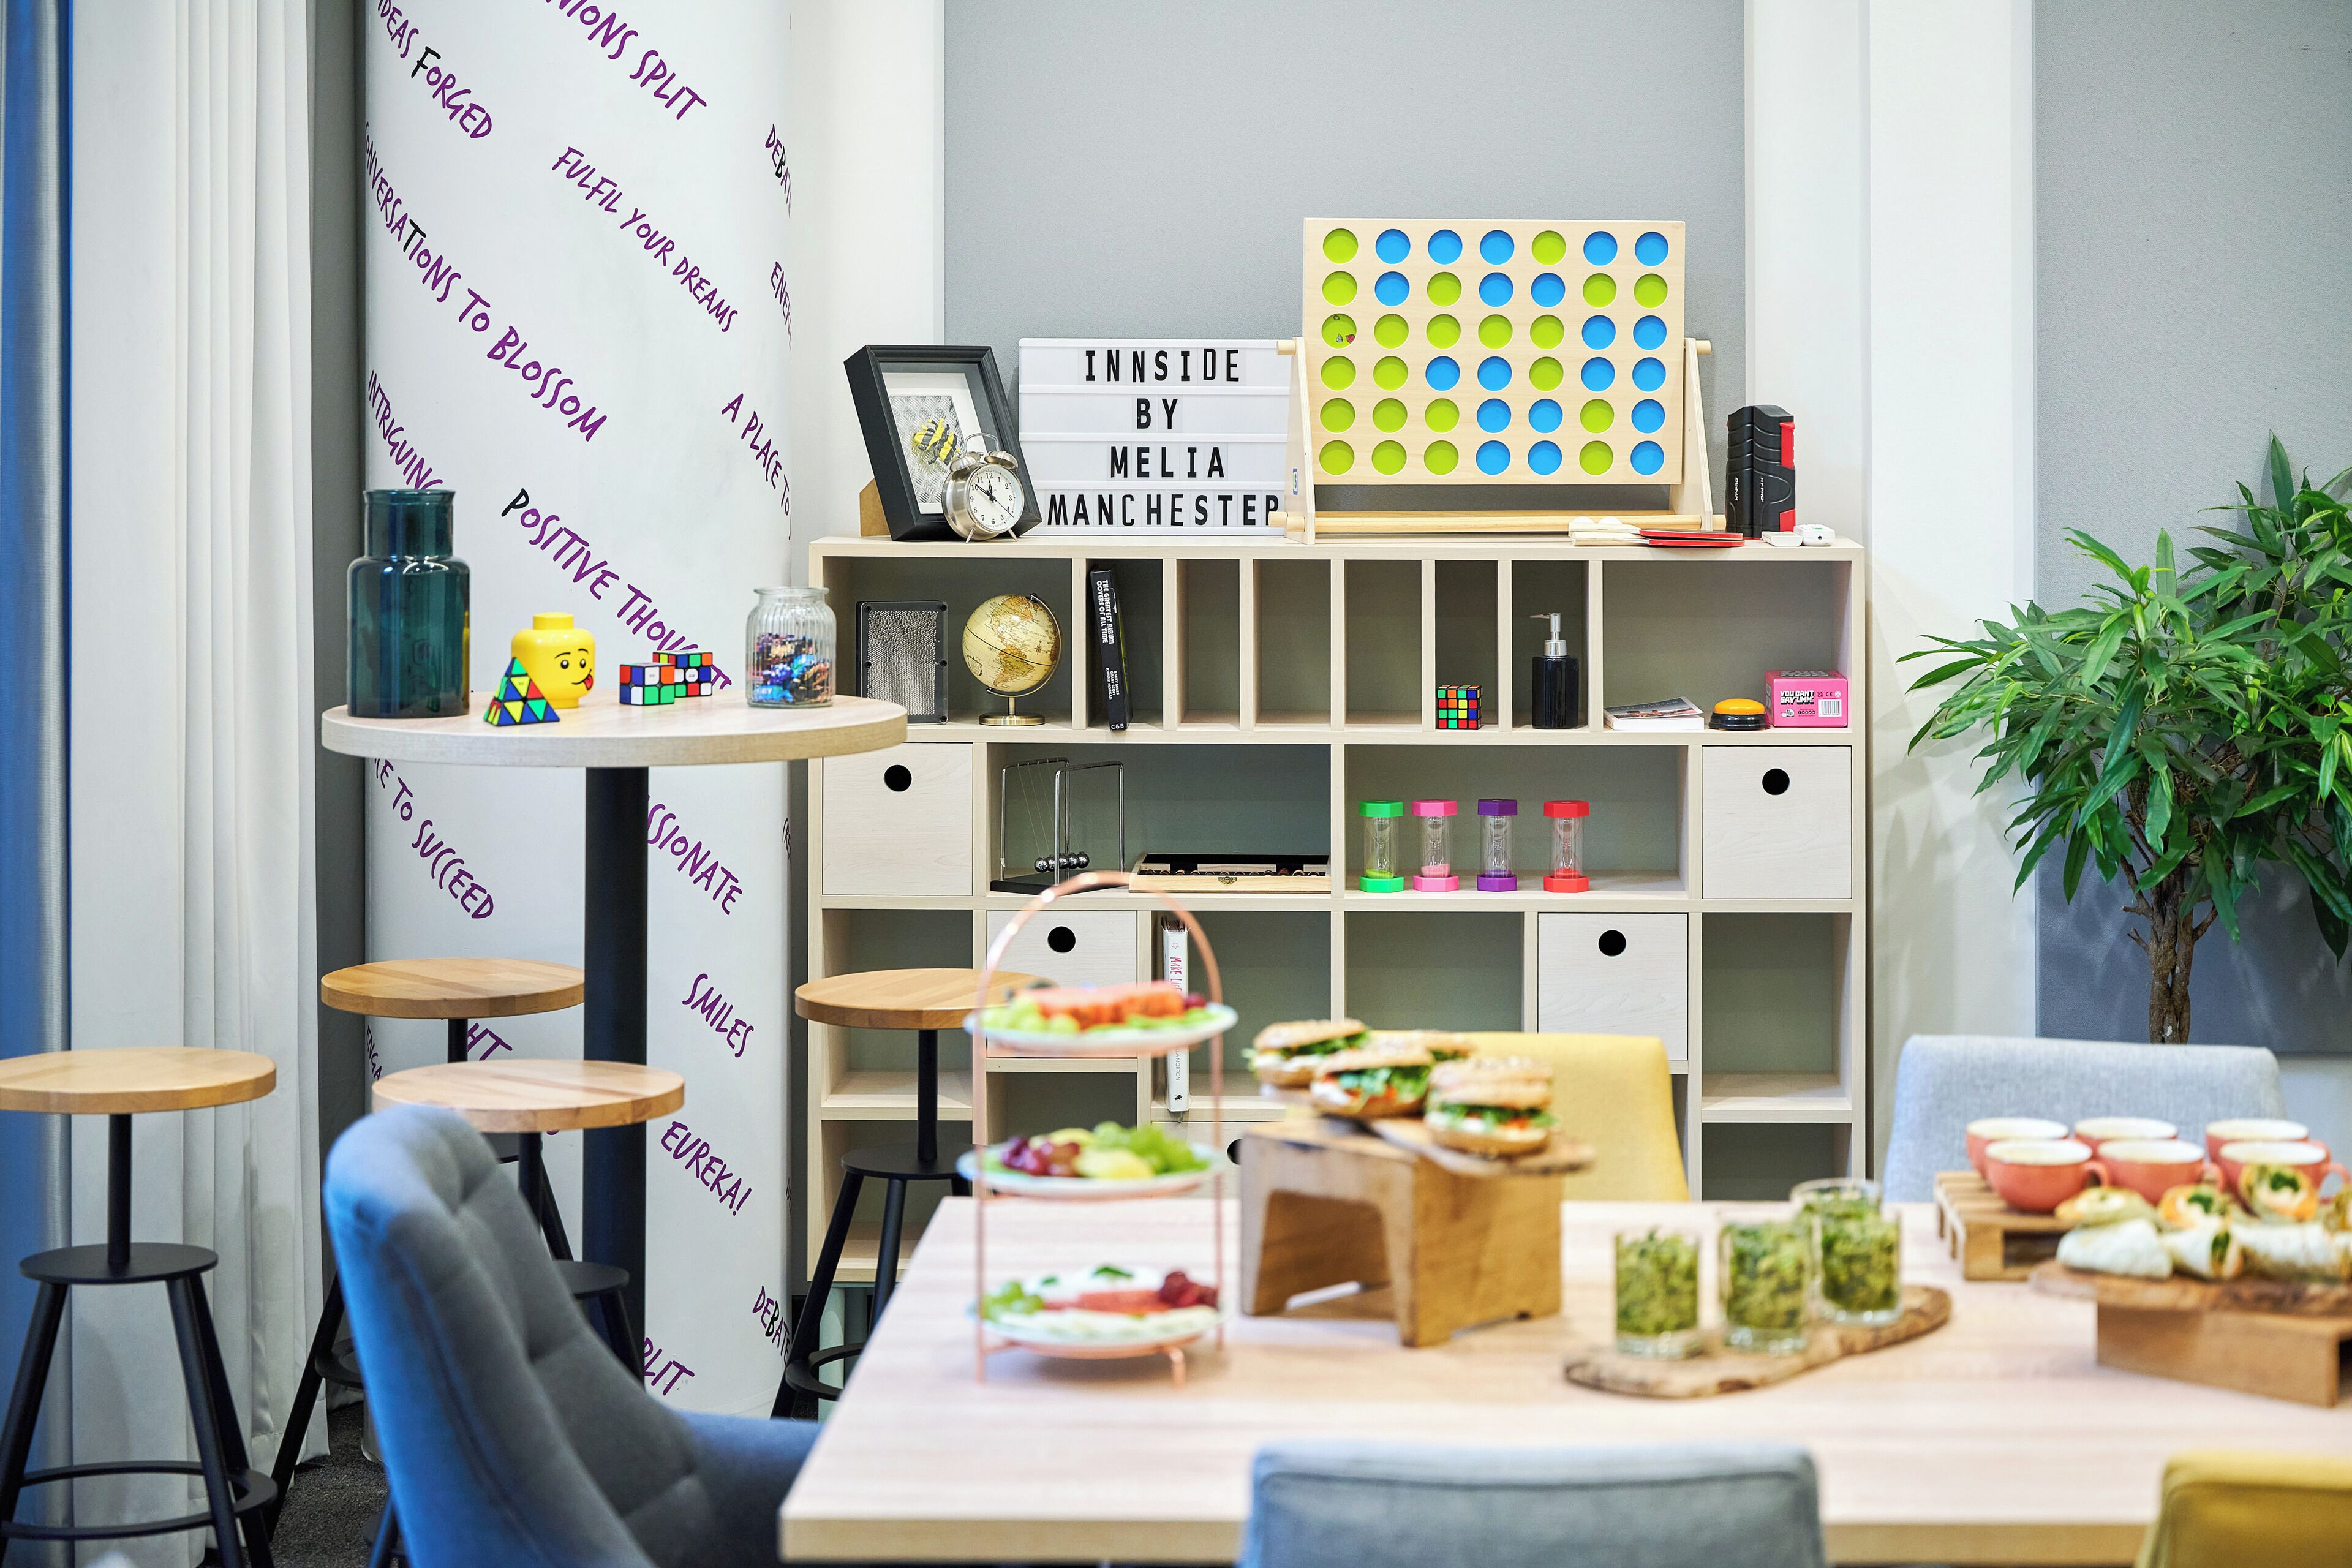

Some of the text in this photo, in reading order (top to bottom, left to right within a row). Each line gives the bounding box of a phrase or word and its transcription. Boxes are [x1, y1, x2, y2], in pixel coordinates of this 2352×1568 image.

[411, 46, 492, 138] FORGED
[546, 0, 706, 120] IONS SPLIT
[552, 146, 738, 333] FULFIL YOUR DREAMS
[459, 288, 491, 332] TO
[487, 326, 608, 442] BLOSSOM
[1085, 349, 1239, 383] INNSIDE
[722, 393, 744, 423] A
[741, 410, 782, 490] PLACE
[1136, 398, 1178, 429] BY
[1110, 446, 1224, 478] MELIA
[501, 488, 620, 600] POSITIVE
[1099, 606, 1106, 616] OF
[1104, 592, 1112, 622] GREATEST
[392, 776, 413, 821] TO
[412, 820, 494, 919] SUCCEED
[647, 794, 742, 915] SSIONATE
[1170, 957, 1182, 974] MAKE
[682, 973, 754, 1058] SMILES
[662, 1121, 752, 1216] EUREKA!
[752, 1286, 792, 1366] DEBATE
